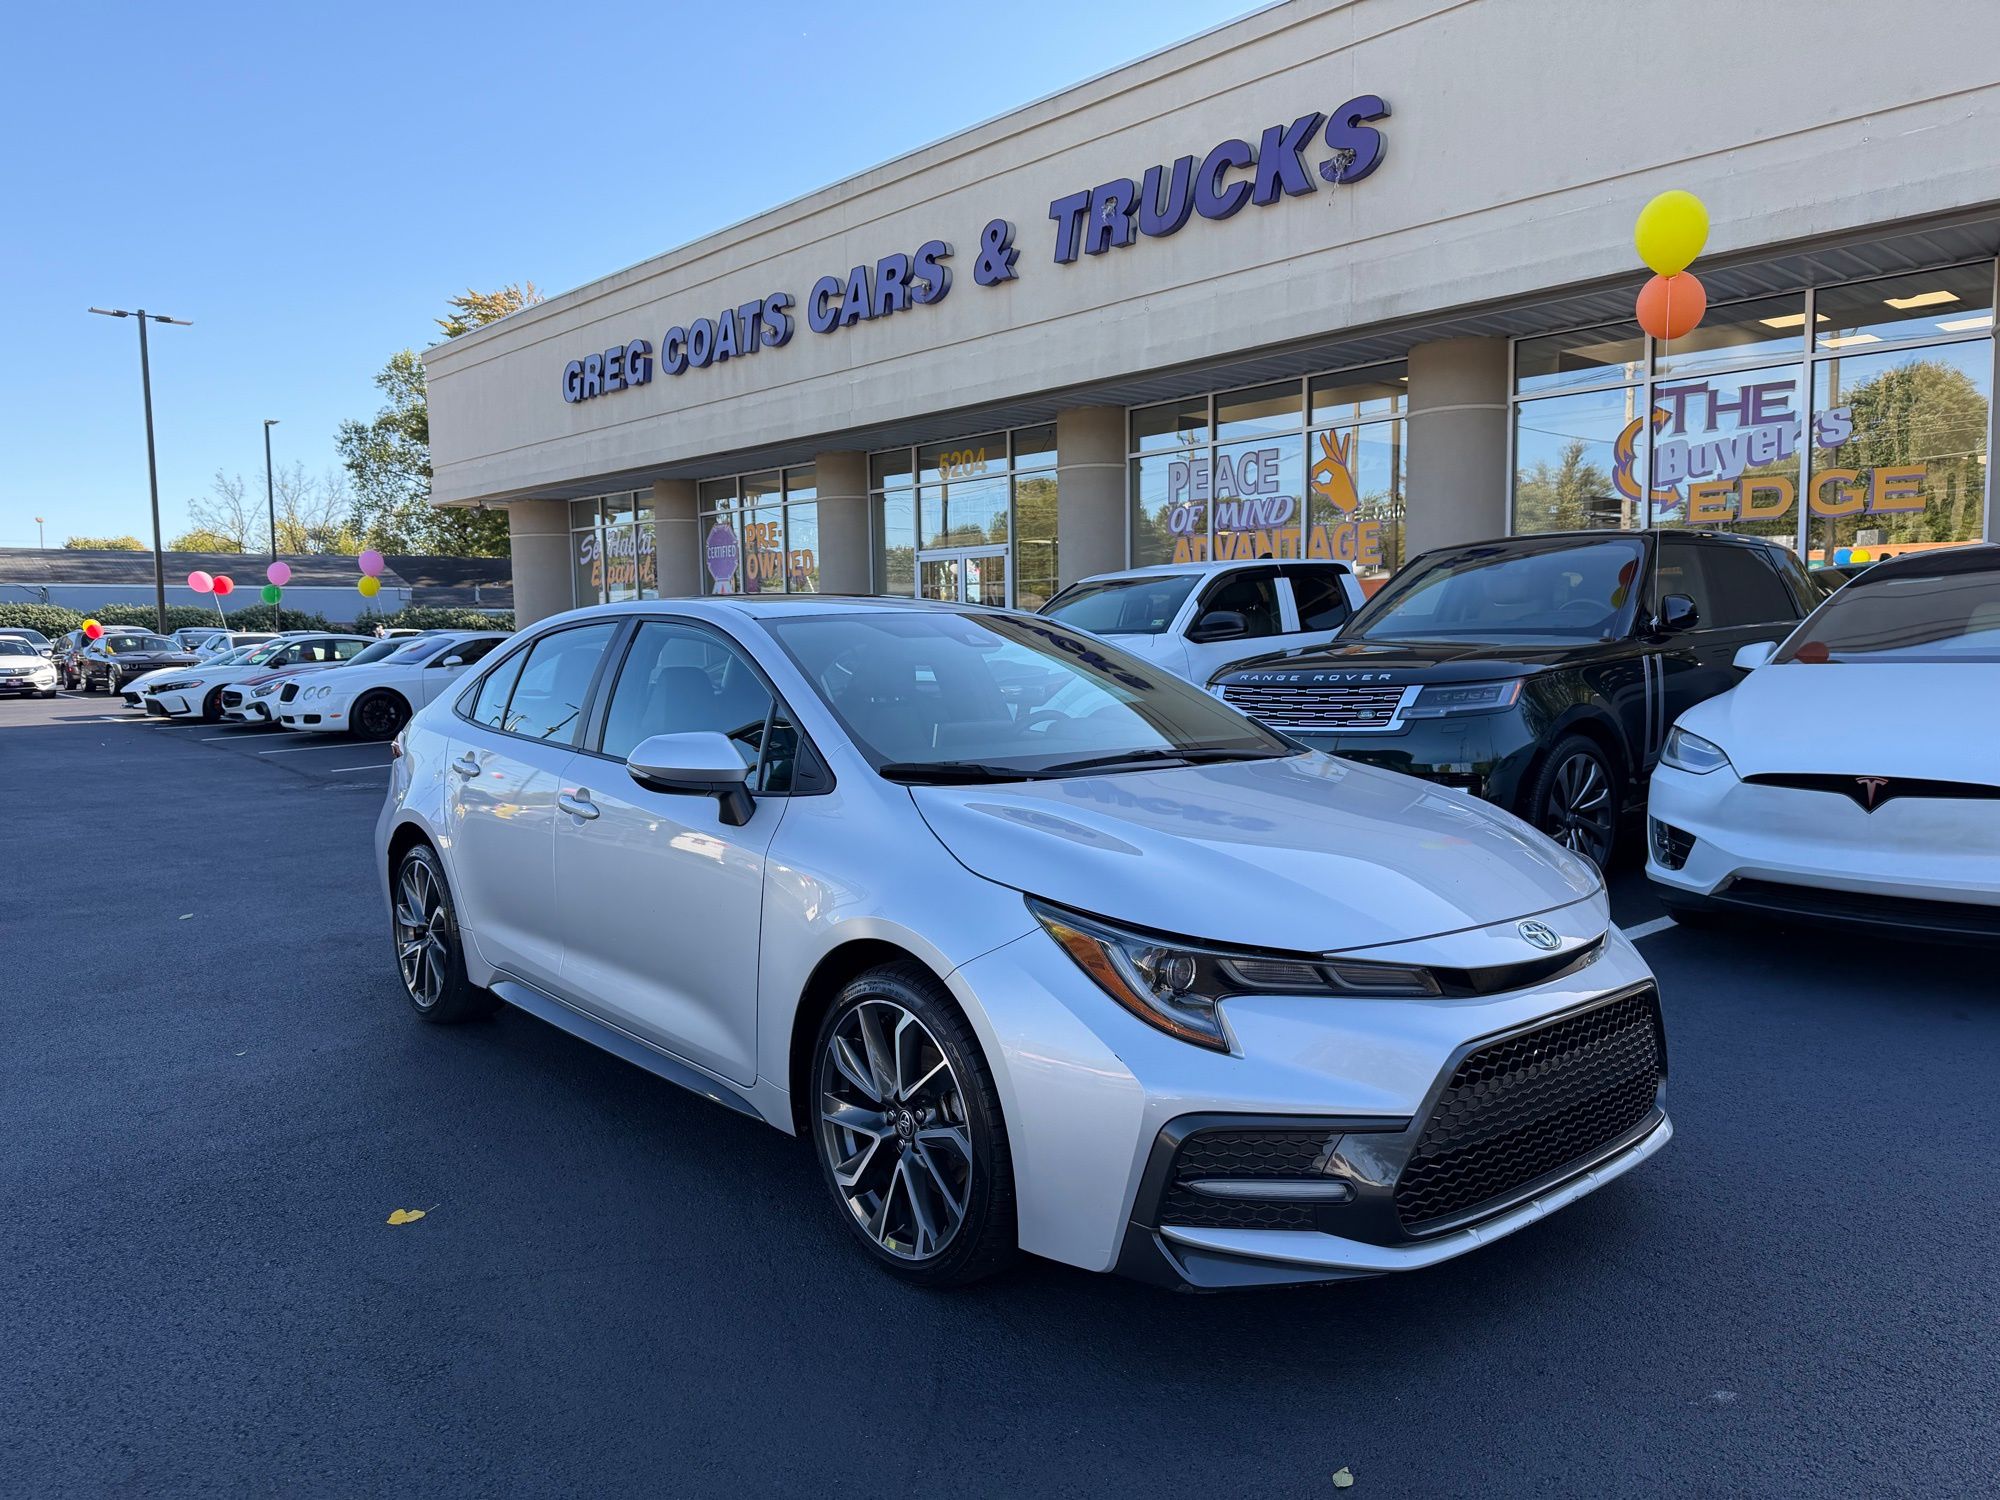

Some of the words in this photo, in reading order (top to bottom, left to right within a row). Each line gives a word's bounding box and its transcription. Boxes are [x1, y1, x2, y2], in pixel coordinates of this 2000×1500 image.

[562, 338, 652, 403] GREG
[661, 291, 795, 376] COATS
[807, 239, 954, 334] CARS
[973, 218, 1020, 288] &
[1049, 93, 1392, 265] TRUCKS
[1653, 379, 1796, 437] THE
[937, 447, 988, 481] 5204
[1168, 447, 1280, 504] PEACE
[1685, 463, 1928, 525] EDGE
[1169, 505, 1205, 535] OF
[1214, 495, 1296, 533] MIND
[580, 534, 602, 565] Se
[707, 545, 737, 560] CERTIFIED
[745, 521, 783, 549] PRE-
[591, 554, 655, 591] Epañl
[746, 548, 815, 580] OWNED
[1239, 674, 1301, 682] RANGE
[1313, 673, 1393, 682] ROVER
